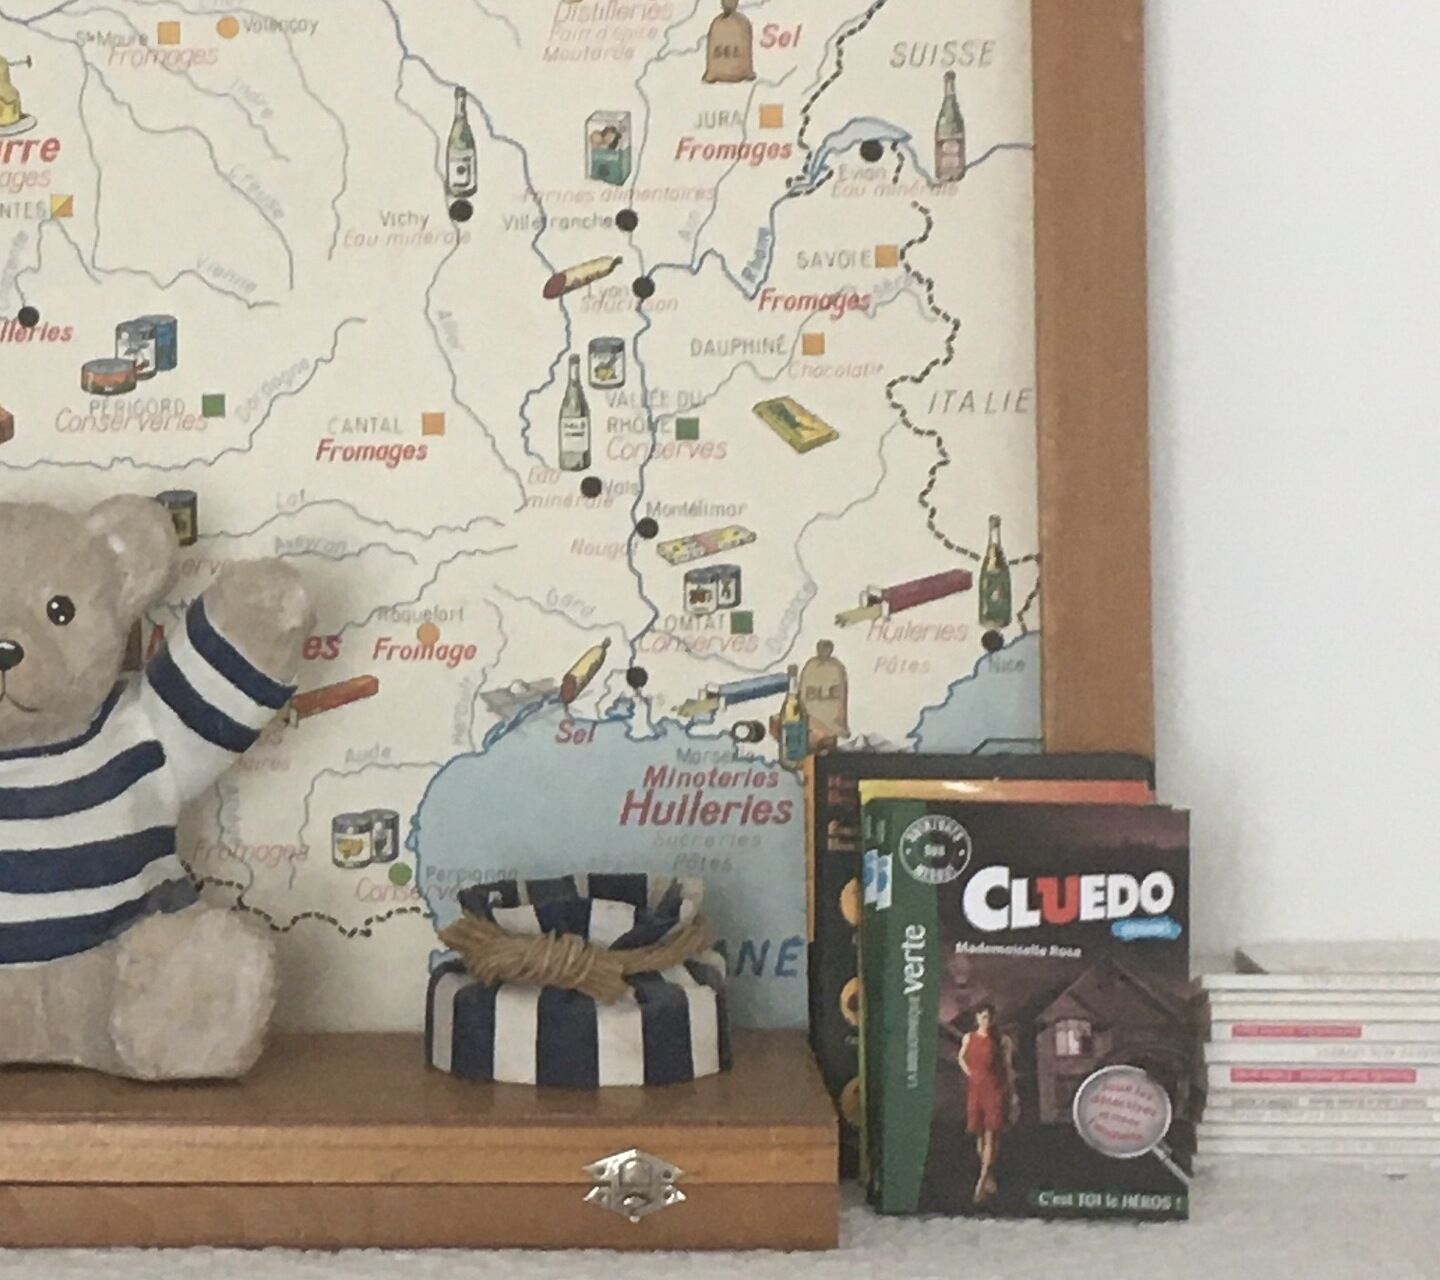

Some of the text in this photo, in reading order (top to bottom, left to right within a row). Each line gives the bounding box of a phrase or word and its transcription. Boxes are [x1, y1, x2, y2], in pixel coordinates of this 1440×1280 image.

[760, 23, 802, 48] Sel
[890, 39, 997, 68] SUISSE
[675, 137, 793, 165] Fromages
[379, 209, 429, 229] Vichy
[797, 251, 872, 270] SAVOIE
[759, 288, 871, 320] Fromages
[928, 388, 1033, 414] ITALIE
[315, 439, 428, 468] Fromages
[372, 637, 477, 667] Fromage
[556, 720, 596, 744] Sel
[643, 765, 779, 790] Minoteries
[620, 789, 794, 827] Huileries
[963, 865, 1174, 932] CLUEDO
[902, 923, 927, 994] verte
